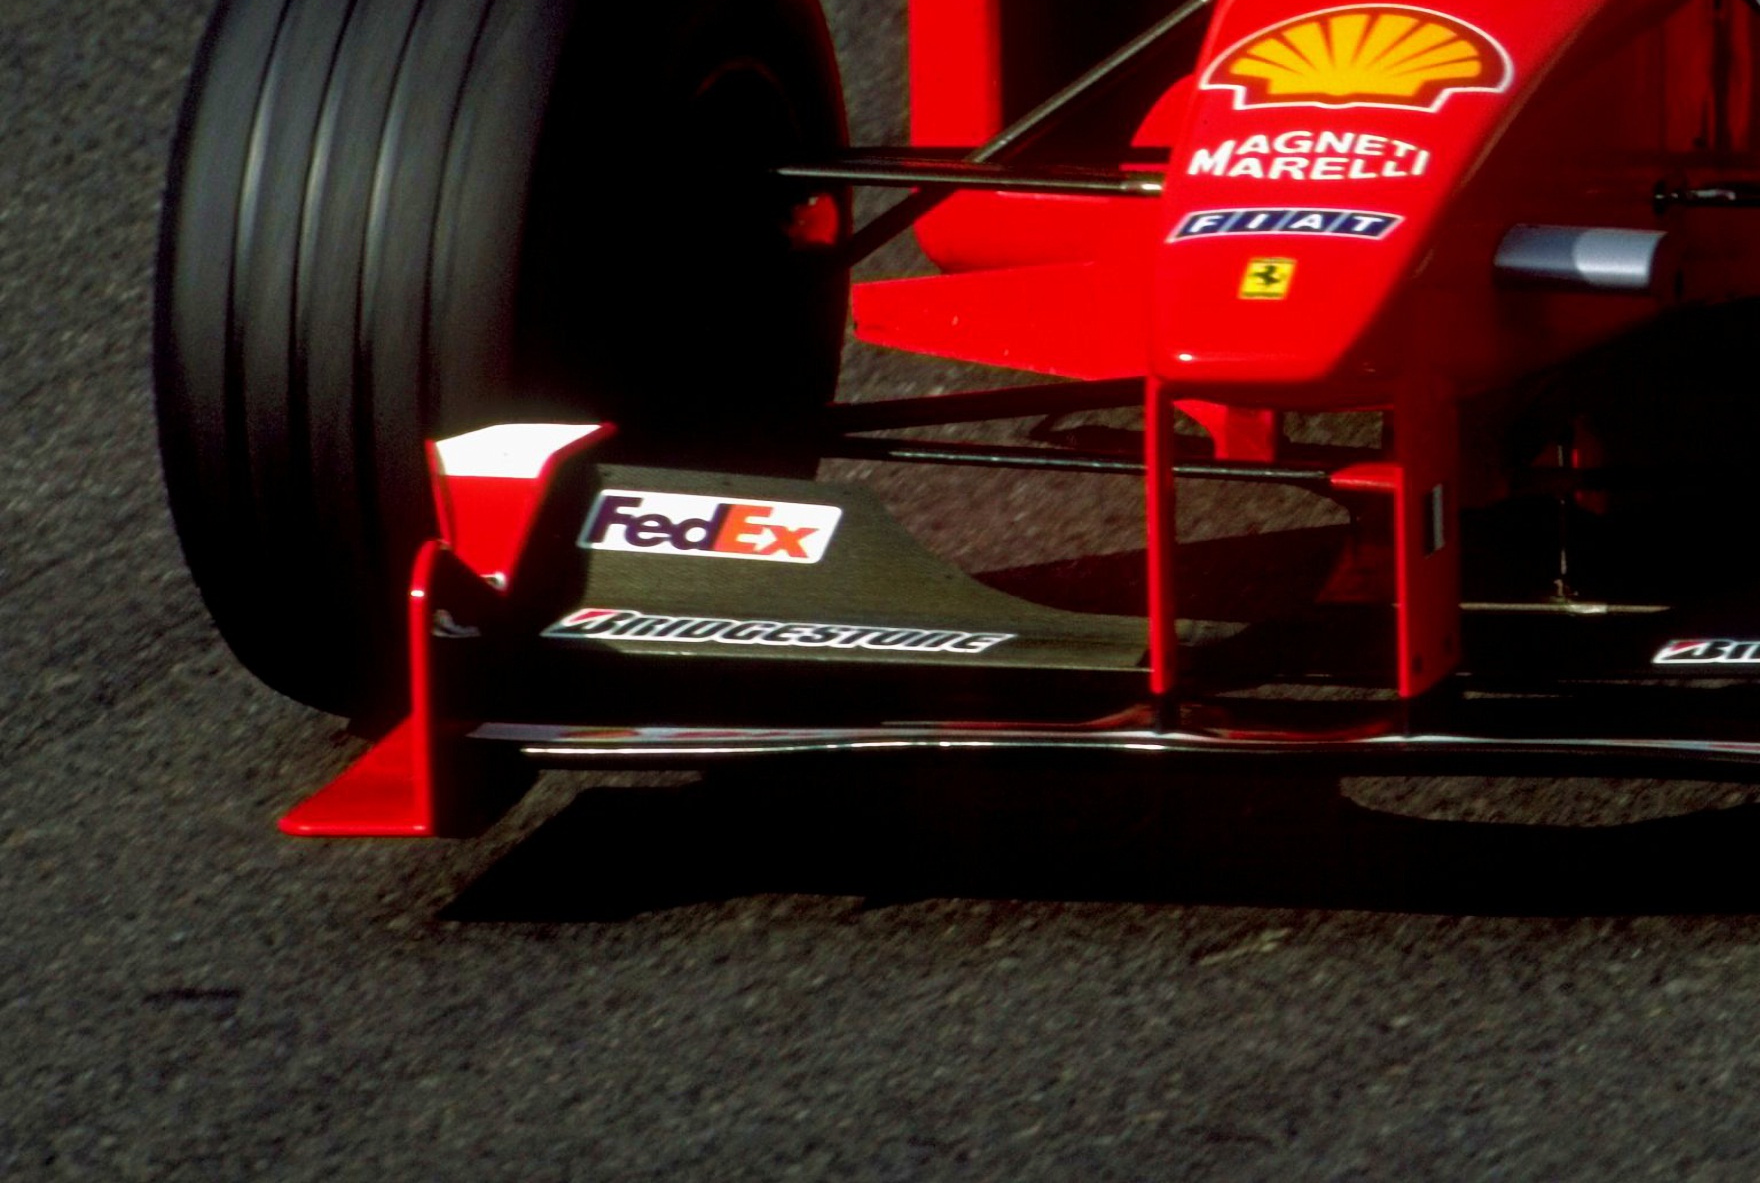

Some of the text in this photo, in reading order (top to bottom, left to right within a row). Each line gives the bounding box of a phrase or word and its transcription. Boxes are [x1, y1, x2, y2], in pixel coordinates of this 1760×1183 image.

[1188, 130, 1431, 166] MAGNETI
[1188, 140, 1431, 180] MARELLI
[1189, 214, 1384, 233] FIAT
[591, 496, 818, 559] FedEx
[545, 608, 1015, 653] BRIDGESTONE
